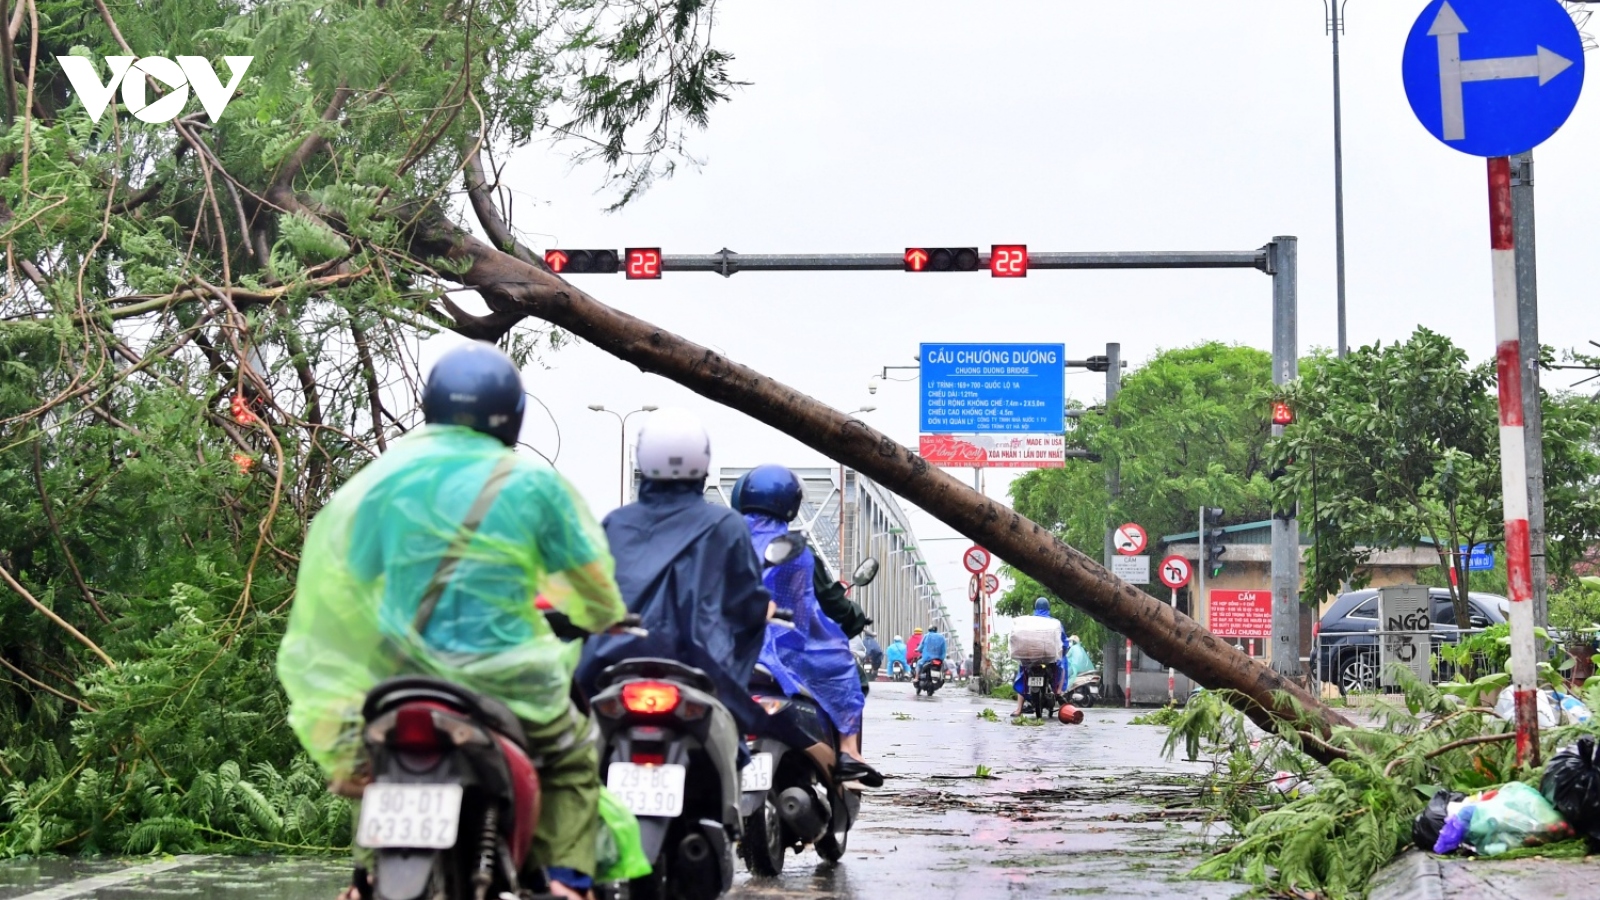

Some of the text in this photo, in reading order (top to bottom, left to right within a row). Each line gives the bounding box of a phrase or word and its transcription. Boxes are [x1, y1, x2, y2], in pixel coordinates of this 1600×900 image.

[632, 253, 656, 274] 22
[996, 250, 1022, 272] 22
[956, 349, 1010, 364] CHƯƠNG
[1012, 349, 1056, 364] DƯƠNG
[1036, 450, 1047, 458] DUY
[1238, 591, 1256, 600] CẤM
[1388, 608, 1430, 631] NGÕ
[621, 768, 670, 788] 29-BC
